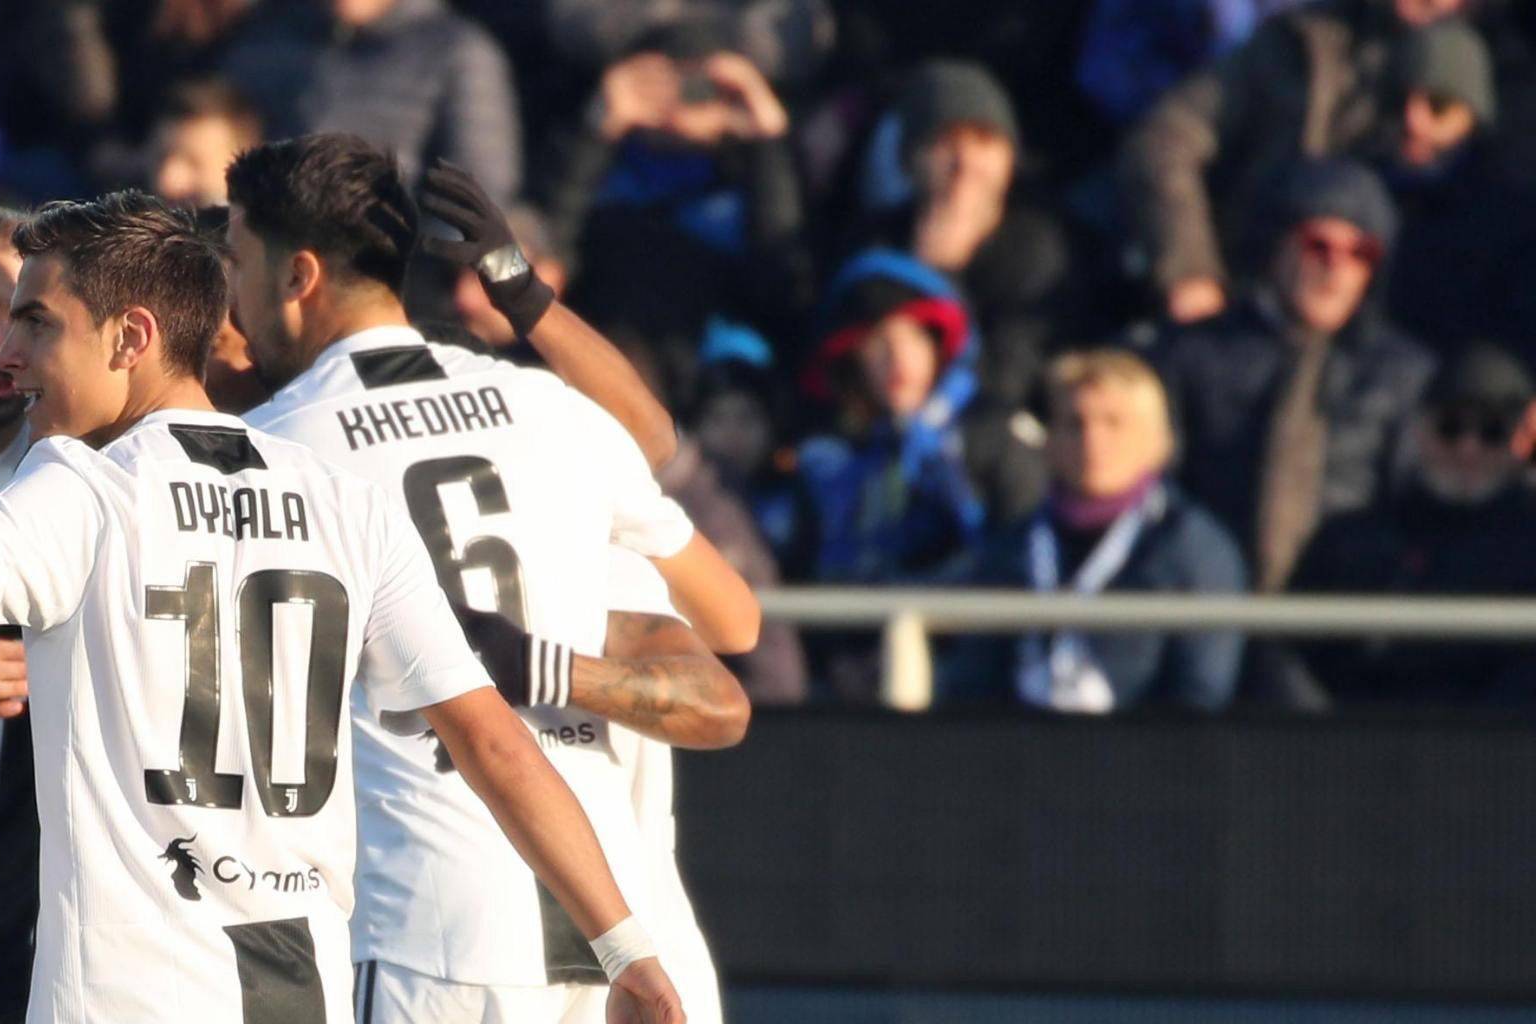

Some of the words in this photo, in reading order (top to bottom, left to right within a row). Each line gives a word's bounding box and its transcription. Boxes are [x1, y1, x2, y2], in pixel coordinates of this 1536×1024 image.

[336, 386, 514, 451] KHEDIRA
[169, 482, 309, 541] DYBALA
[379, 455, 531, 737] 6
[144, 560, 350, 818] 10
